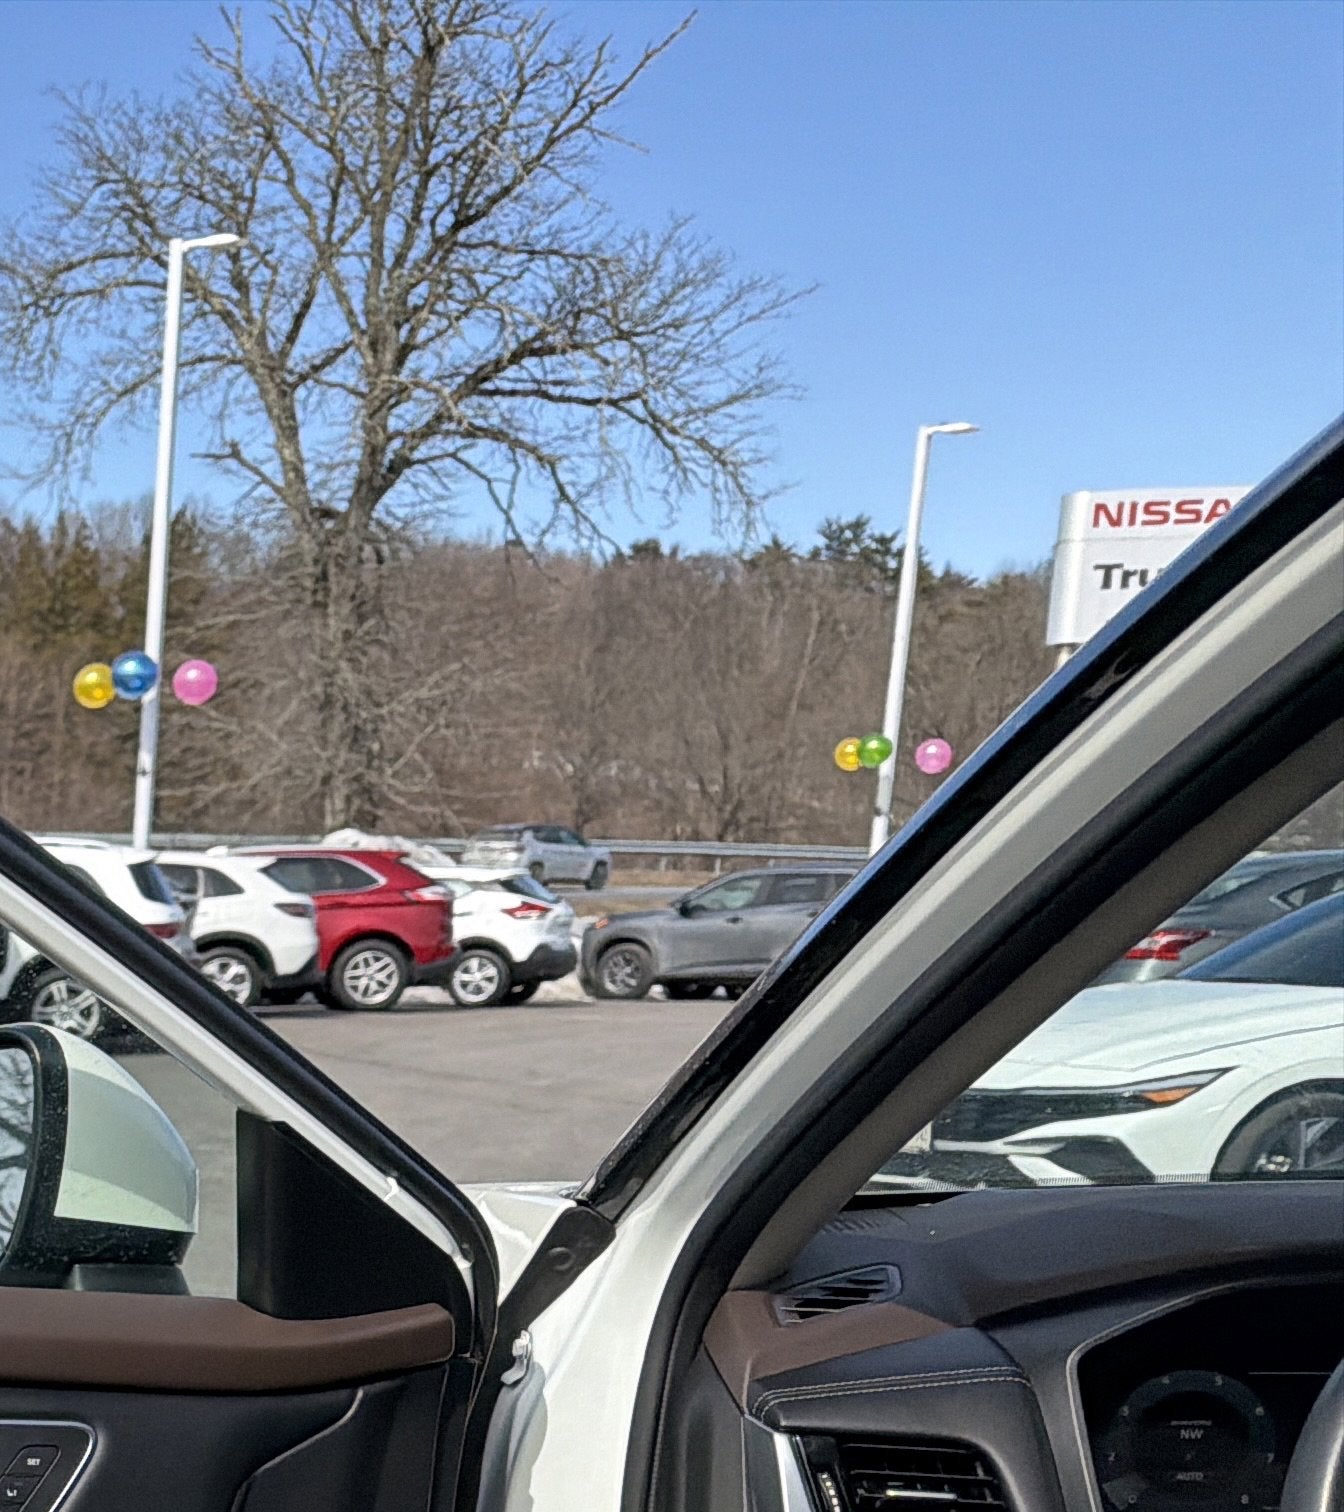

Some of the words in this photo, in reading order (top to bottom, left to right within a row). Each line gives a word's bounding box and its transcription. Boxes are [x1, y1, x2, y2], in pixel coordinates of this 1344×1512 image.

[1093, 498, 1232, 528] NISSA
[1180, 1428, 1204, 1440] NW
[26, 1457, 41, 1466] SET
